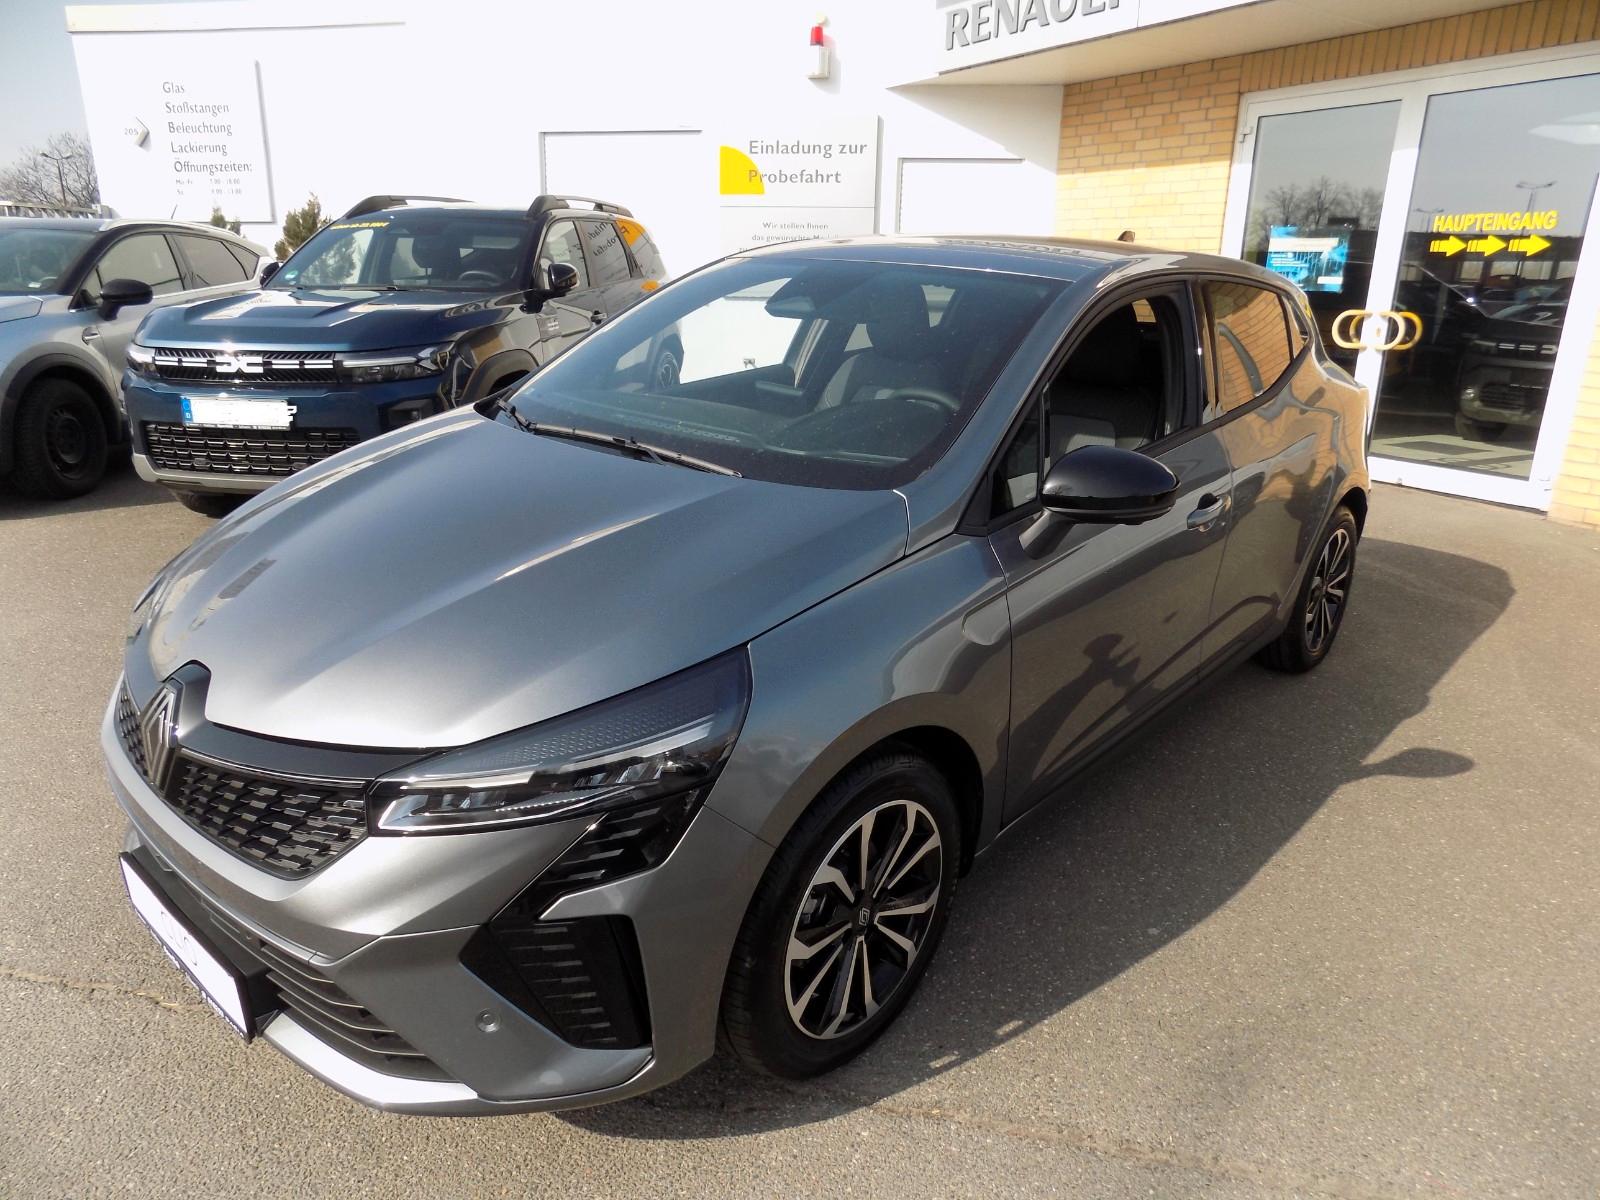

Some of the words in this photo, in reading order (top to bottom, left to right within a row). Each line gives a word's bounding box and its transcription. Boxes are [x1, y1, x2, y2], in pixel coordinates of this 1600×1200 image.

[945, 0, 1120, 50] RENAU
[162, 81, 185, 94] Glas
[165, 101, 230, 117] Stoßstangen
[168, 121, 232, 136] Beleuchtung
[171, 141, 228, 156] Lackierung
[749, 140, 833, 159] Einladung
[838, 143, 868, 155] zur
[174, 157, 252, 176] Öffnungszeiten:
[748, 169, 842, 184] Probefahrt
[762, 221, 778, 229] Wir
[1432, 210, 1559, 233] HAUPTEINGANG
